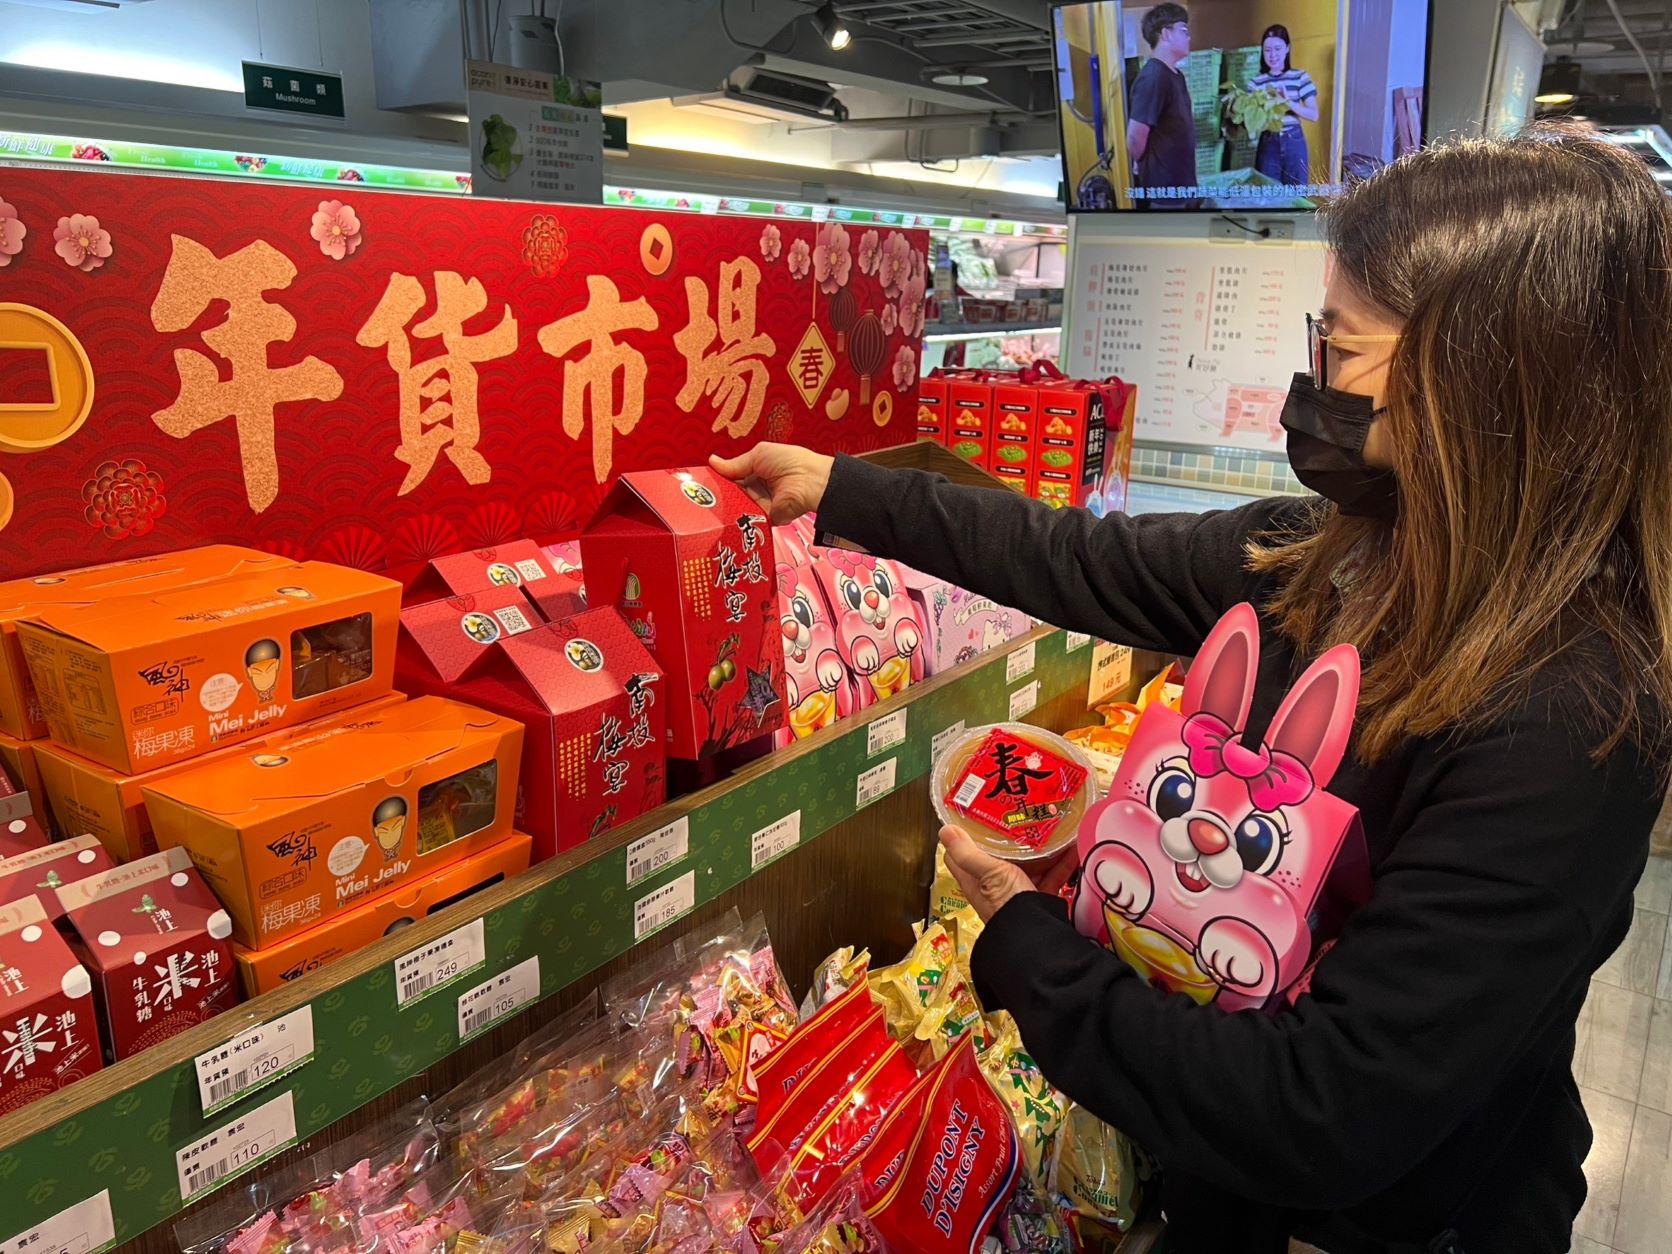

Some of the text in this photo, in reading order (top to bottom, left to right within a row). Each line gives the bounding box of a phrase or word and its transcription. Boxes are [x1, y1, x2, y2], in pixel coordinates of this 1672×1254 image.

[275, 92, 316, 106] Mushroom
[150, 234, 776, 514] 年貨市場
[799, 347, 824, 390] 春
[208, 710, 229, 722] Mini
[209, 714, 243, 736] Mei
[248, 704, 287, 724] Jelly
[134, 725, 195, 760] 梅果凍
[653, 851, 668, 867] 200
[774, 841, 785, 853] 100
[336, 872, 355, 887] Mini
[336, 874, 368, 900] Mei
[373, 859, 411, 882] Jelly
[155, 908, 179, 932] 池上
[262, 893, 321, 935] 梅果凍
[661, 906, 675, 922] 185
[3, 966, 29, 994] 池上
[152, 950, 201, 1006] 米
[201, 949, 221, 987] 池上
[437, 962, 458, 981] 249
[132, 976, 152, 1023] 牛乳糖
[496, 997, 514, 1014] 105
[1, 1013, 57, 1074] 米
[55, 1010, 79, 1052] 池上
[253, 1056, 280, 1078] 120
[232, 1143, 259, 1164] 110
[921, 1098, 968, 1219] DUPONT
[934, 1115, 986, 1239] D'ISIGNY
[978, 1168, 999, 1198] Assort
